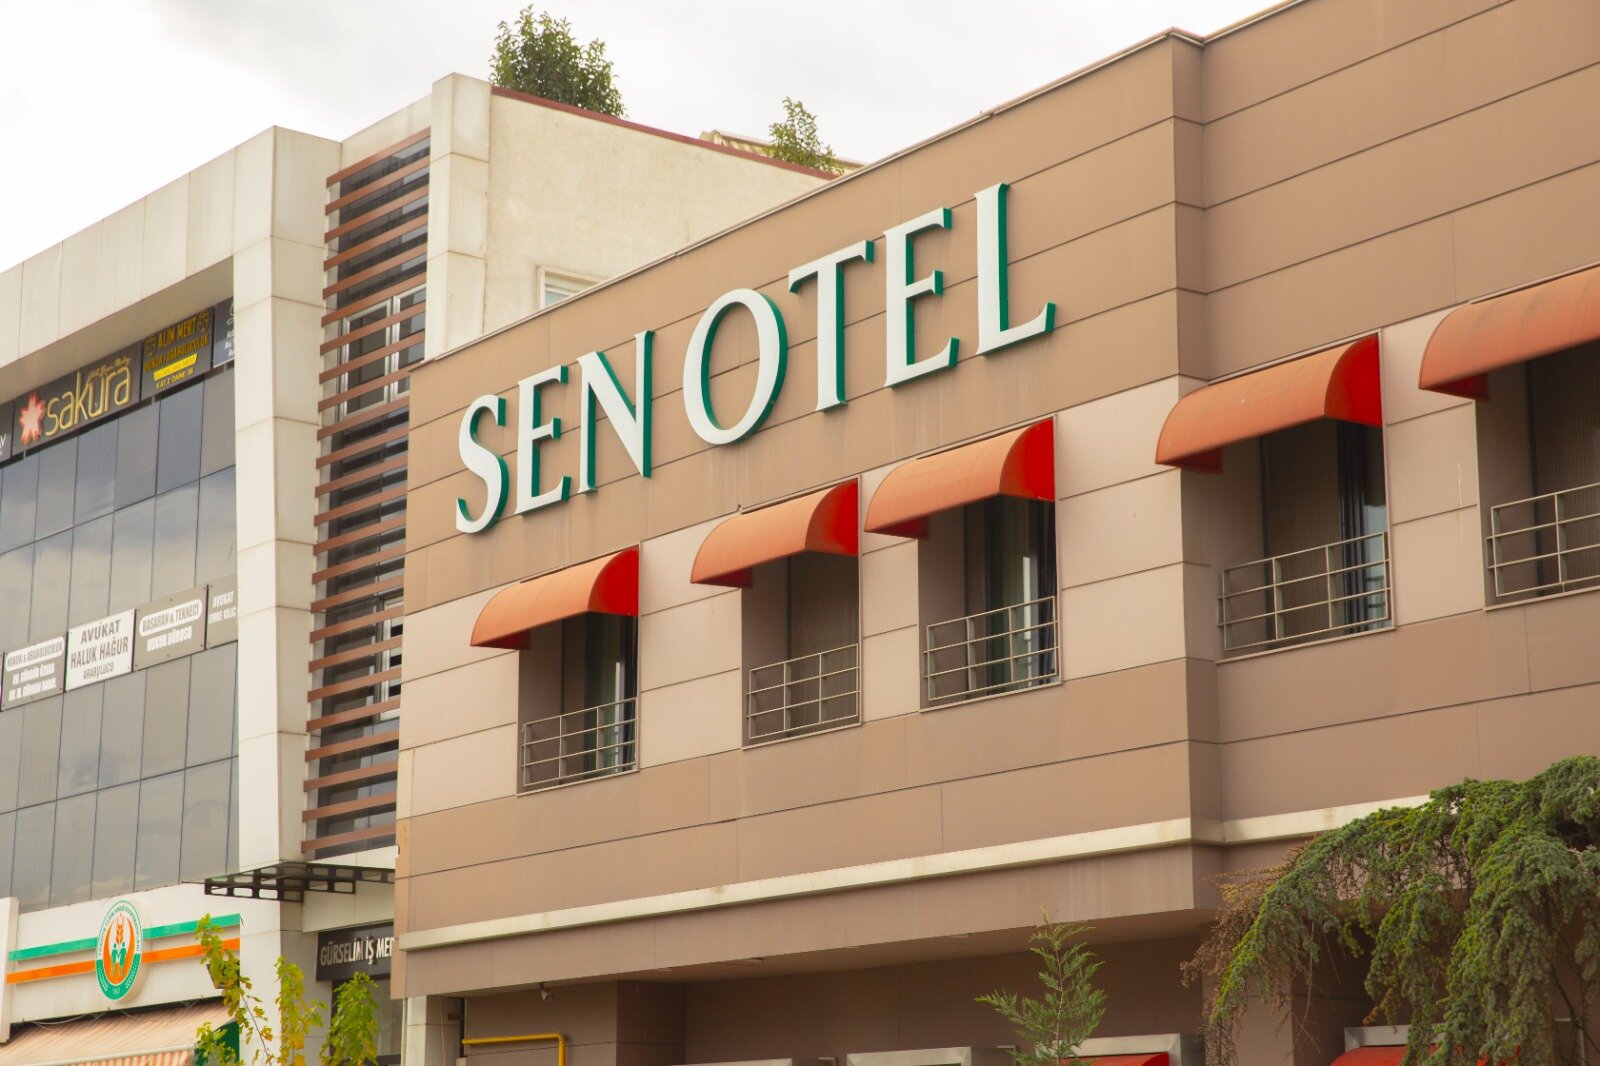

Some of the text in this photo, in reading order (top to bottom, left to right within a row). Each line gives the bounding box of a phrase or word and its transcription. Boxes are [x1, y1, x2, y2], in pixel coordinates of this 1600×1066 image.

[456, 182, 1056, 534] SEN OTEL
[46, 366, 132, 436] sakura
[81, 619, 121, 645] AVUKAT
[70, 637, 129, 669] HALUK HAĞUR
[365, 936, 374, 965] İŞ
